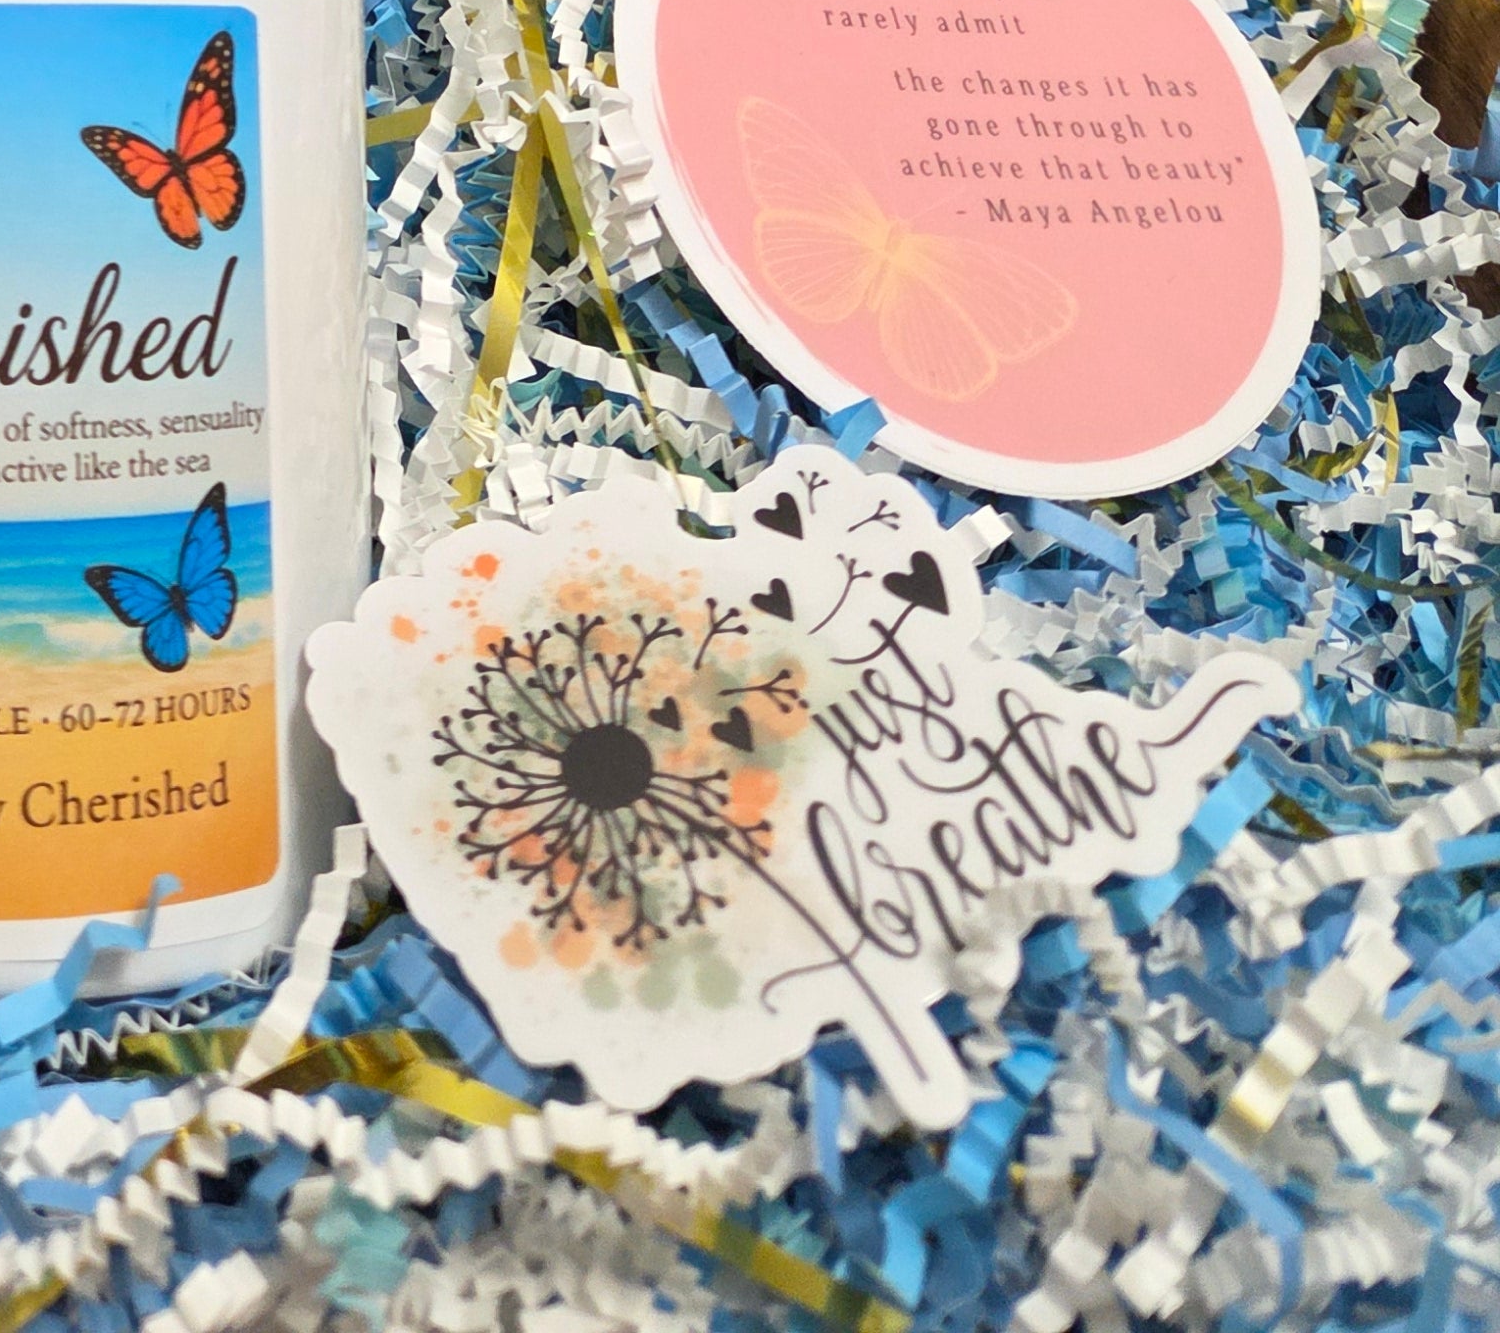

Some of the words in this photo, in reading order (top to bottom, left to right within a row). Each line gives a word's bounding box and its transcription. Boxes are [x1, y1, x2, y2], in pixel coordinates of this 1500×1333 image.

[823, 5, 919, 37] rarely
[936, 10, 1025, 35] admit
[894, 69, 944, 93] the
[962, 73, 1089, 101] changes
[1104, 76, 1130, 97] it
[1143, 74, 1198, 99] has
[926, 115, 1000, 140] gone
[1016, 114, 1146, 143] through
[1161, 116, 1194, 139] to
[900, 155, 1024, 179] achieve
[1040, 156, 1108, 180] that
[988, 199, 1073, 228] Maya
[1090, 199, 1223, 229] Angelou
[3, 413, 32, 443] of
[39, 411, 153, 442] softness,
[160, 401, 264, 435] sensuality
[75, 453, 121, 482] like
[128, 451, 169, 477] the
[175, 453, 211, 475] sea
[154, 683, 252, 725] HOURS
[812, 609, 965, 823] just
[20, 761, 231, 827] Cherished
[760, 680, 1262, 1013] breathe
